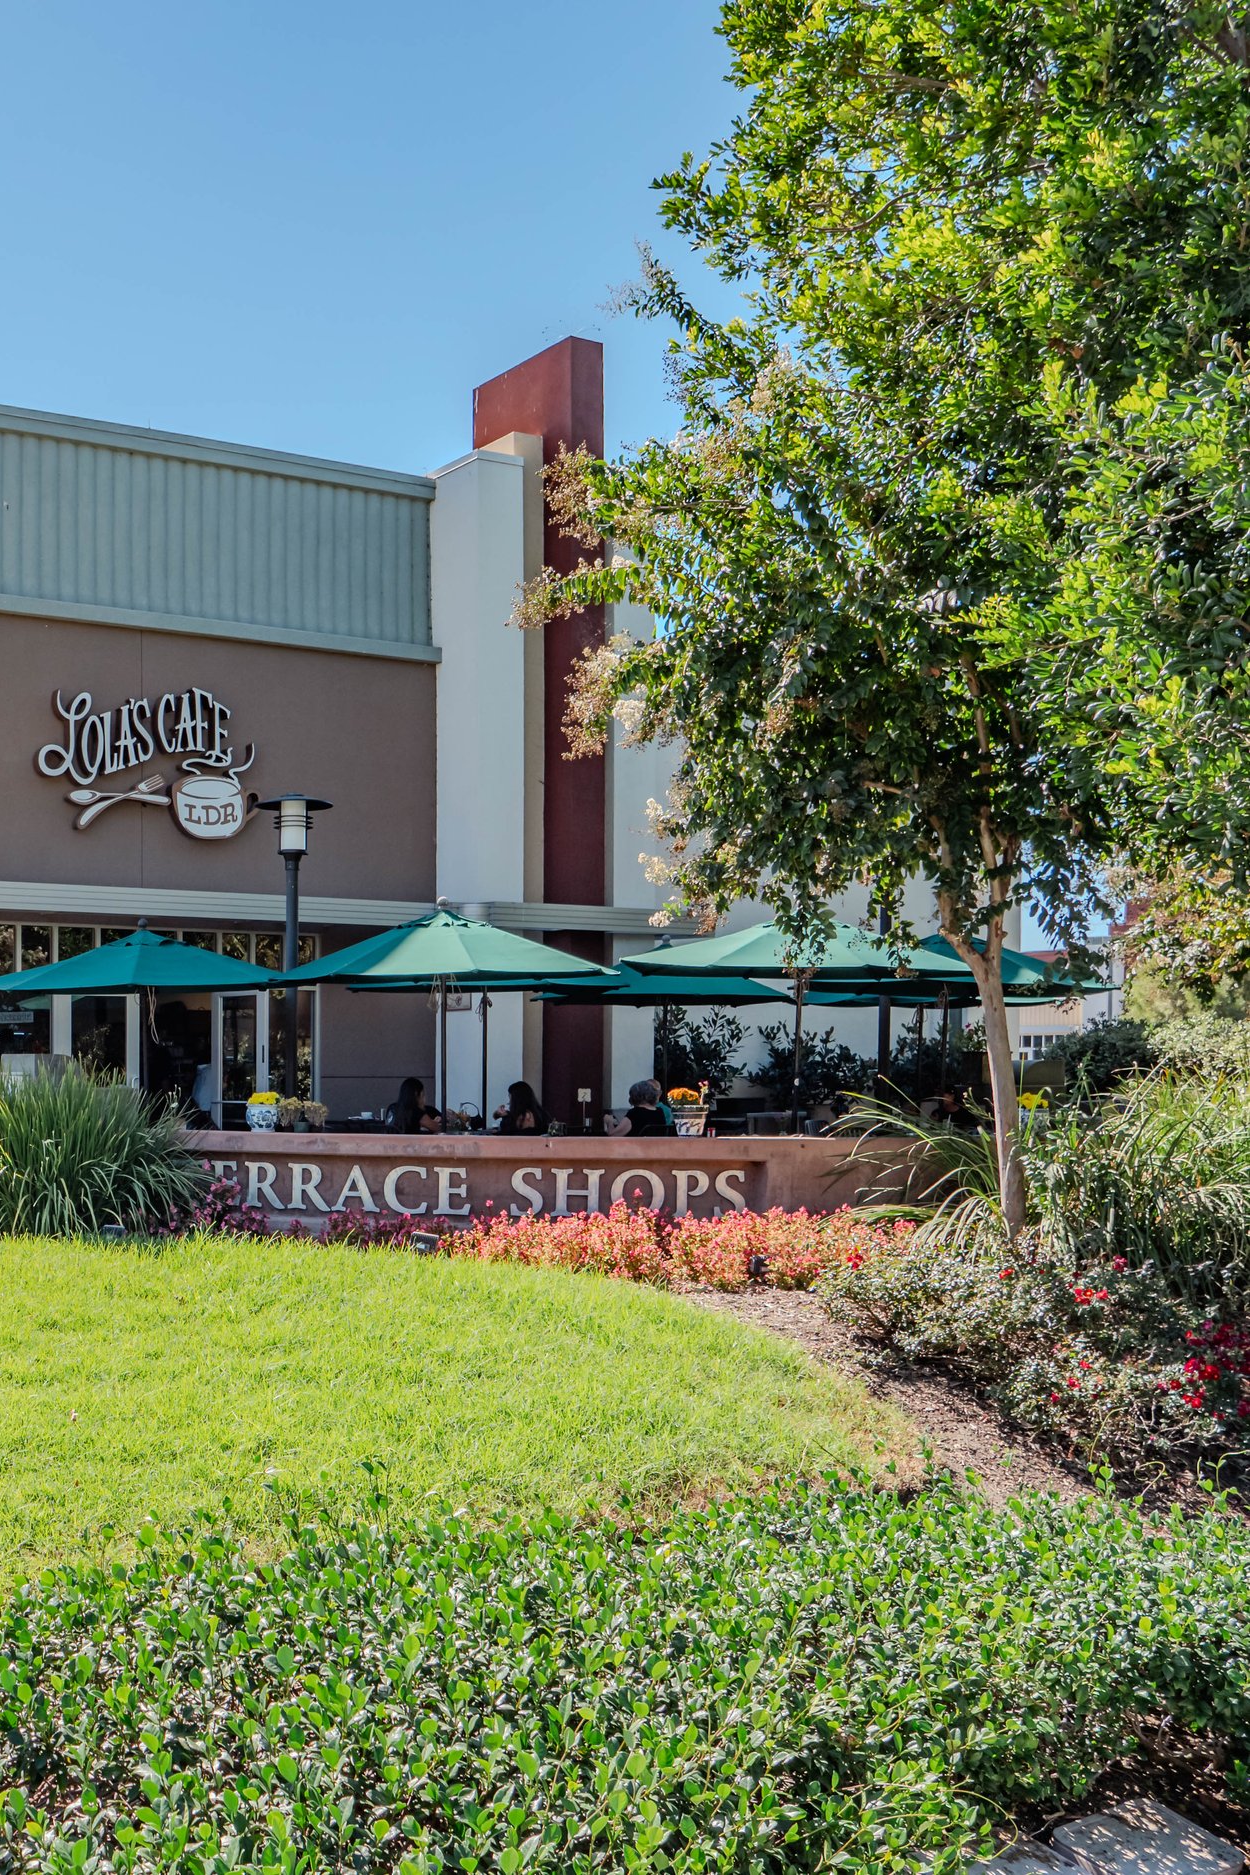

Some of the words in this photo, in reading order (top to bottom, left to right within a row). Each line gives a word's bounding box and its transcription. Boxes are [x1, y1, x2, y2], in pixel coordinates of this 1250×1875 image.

[37, 689, 154, 785] LOLA'S
[157, 687, 231, 760] CAFE
[184, 803, 238, 825] LDR
[206, 1160, 471, 1216] ERRACE
[510, 1167, 746, 1218] SHOPS
